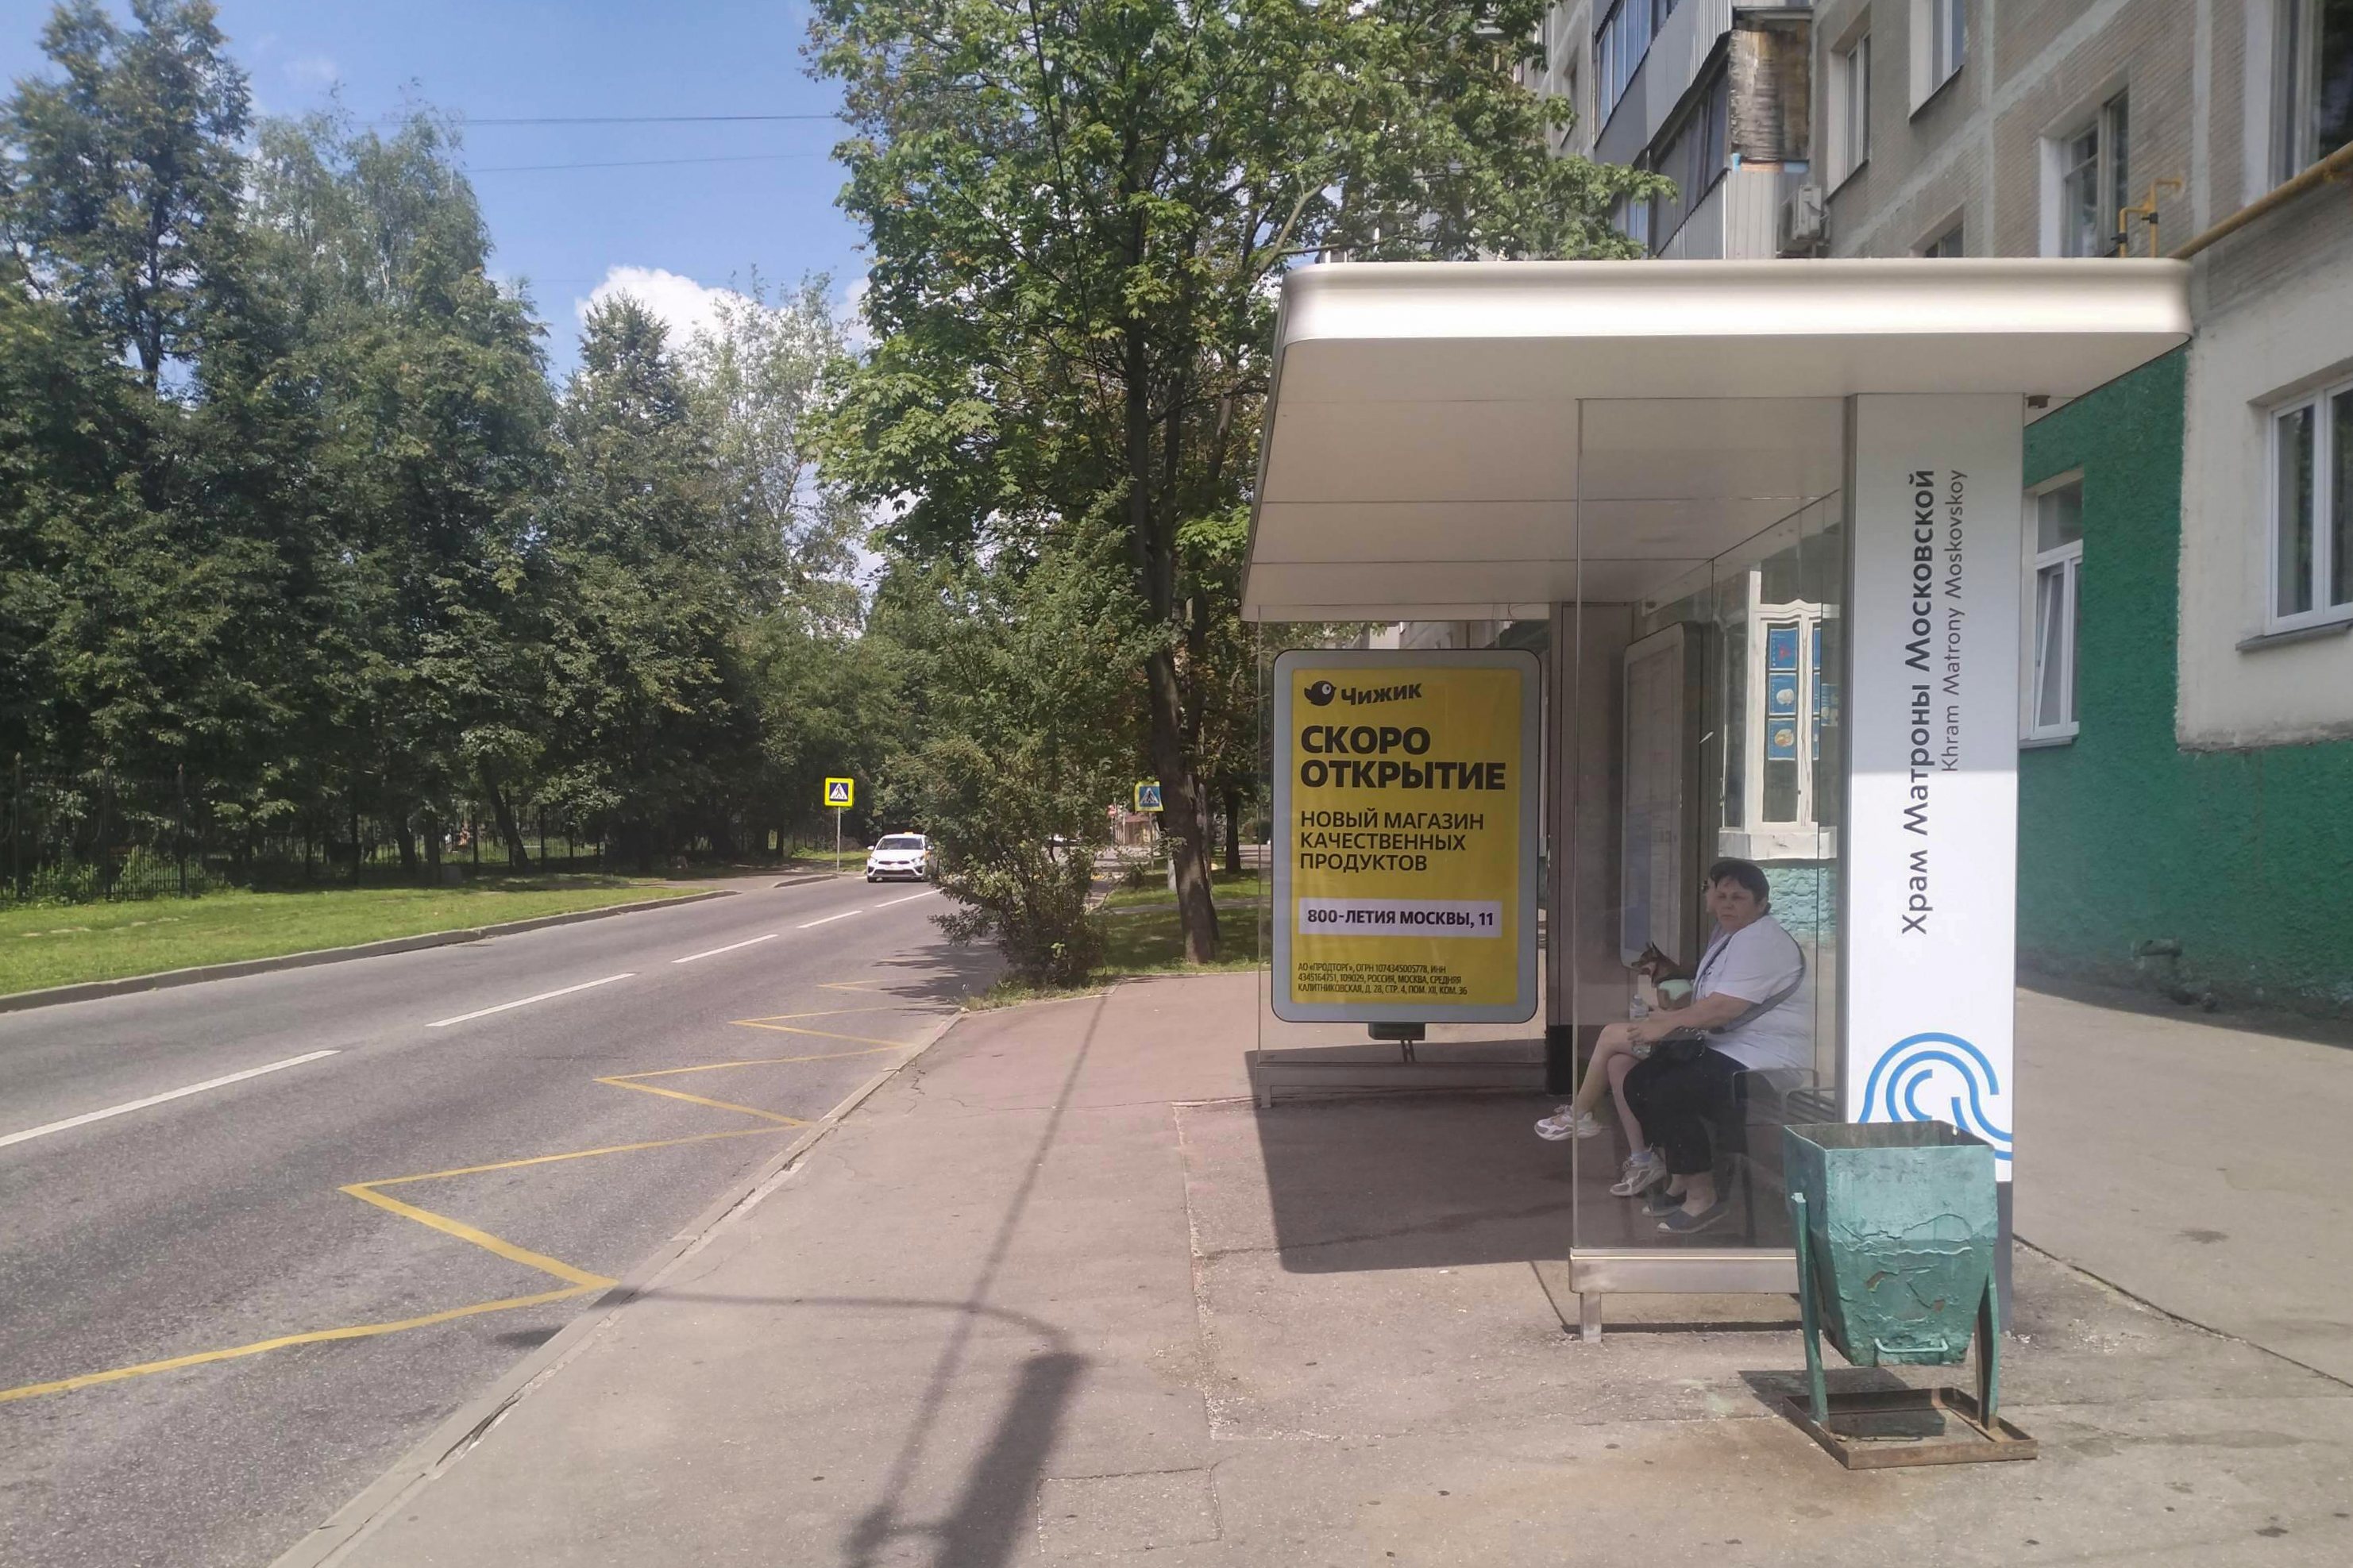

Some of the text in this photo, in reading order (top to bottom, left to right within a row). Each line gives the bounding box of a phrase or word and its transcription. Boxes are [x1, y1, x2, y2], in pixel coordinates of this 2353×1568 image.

[1941, 469, 1968, 772] Khram Matrony Moskovskoy
[1340, 683, 1422, 706] Чижик
[1901, 470, 1935, 934] Храм Матроны Московской
[1300, 725, 1431, 755] СКОРО
[1300, 759, 1506, 790] ОТКРЫТИЕ
[1300, 807, 1484, 830] НОВЫЙ МАГАЗИН
[1299, 831, 1466, 851] КАЧЕСТВЕННЫХ
[1299, 853, 1428, 873] ПРОДУКТОВ
[1306, 908, 1494, 929] 800-ЛЕТИЯ МОСКВЫ, 11
[1298, 962, 1309, 972] АО
